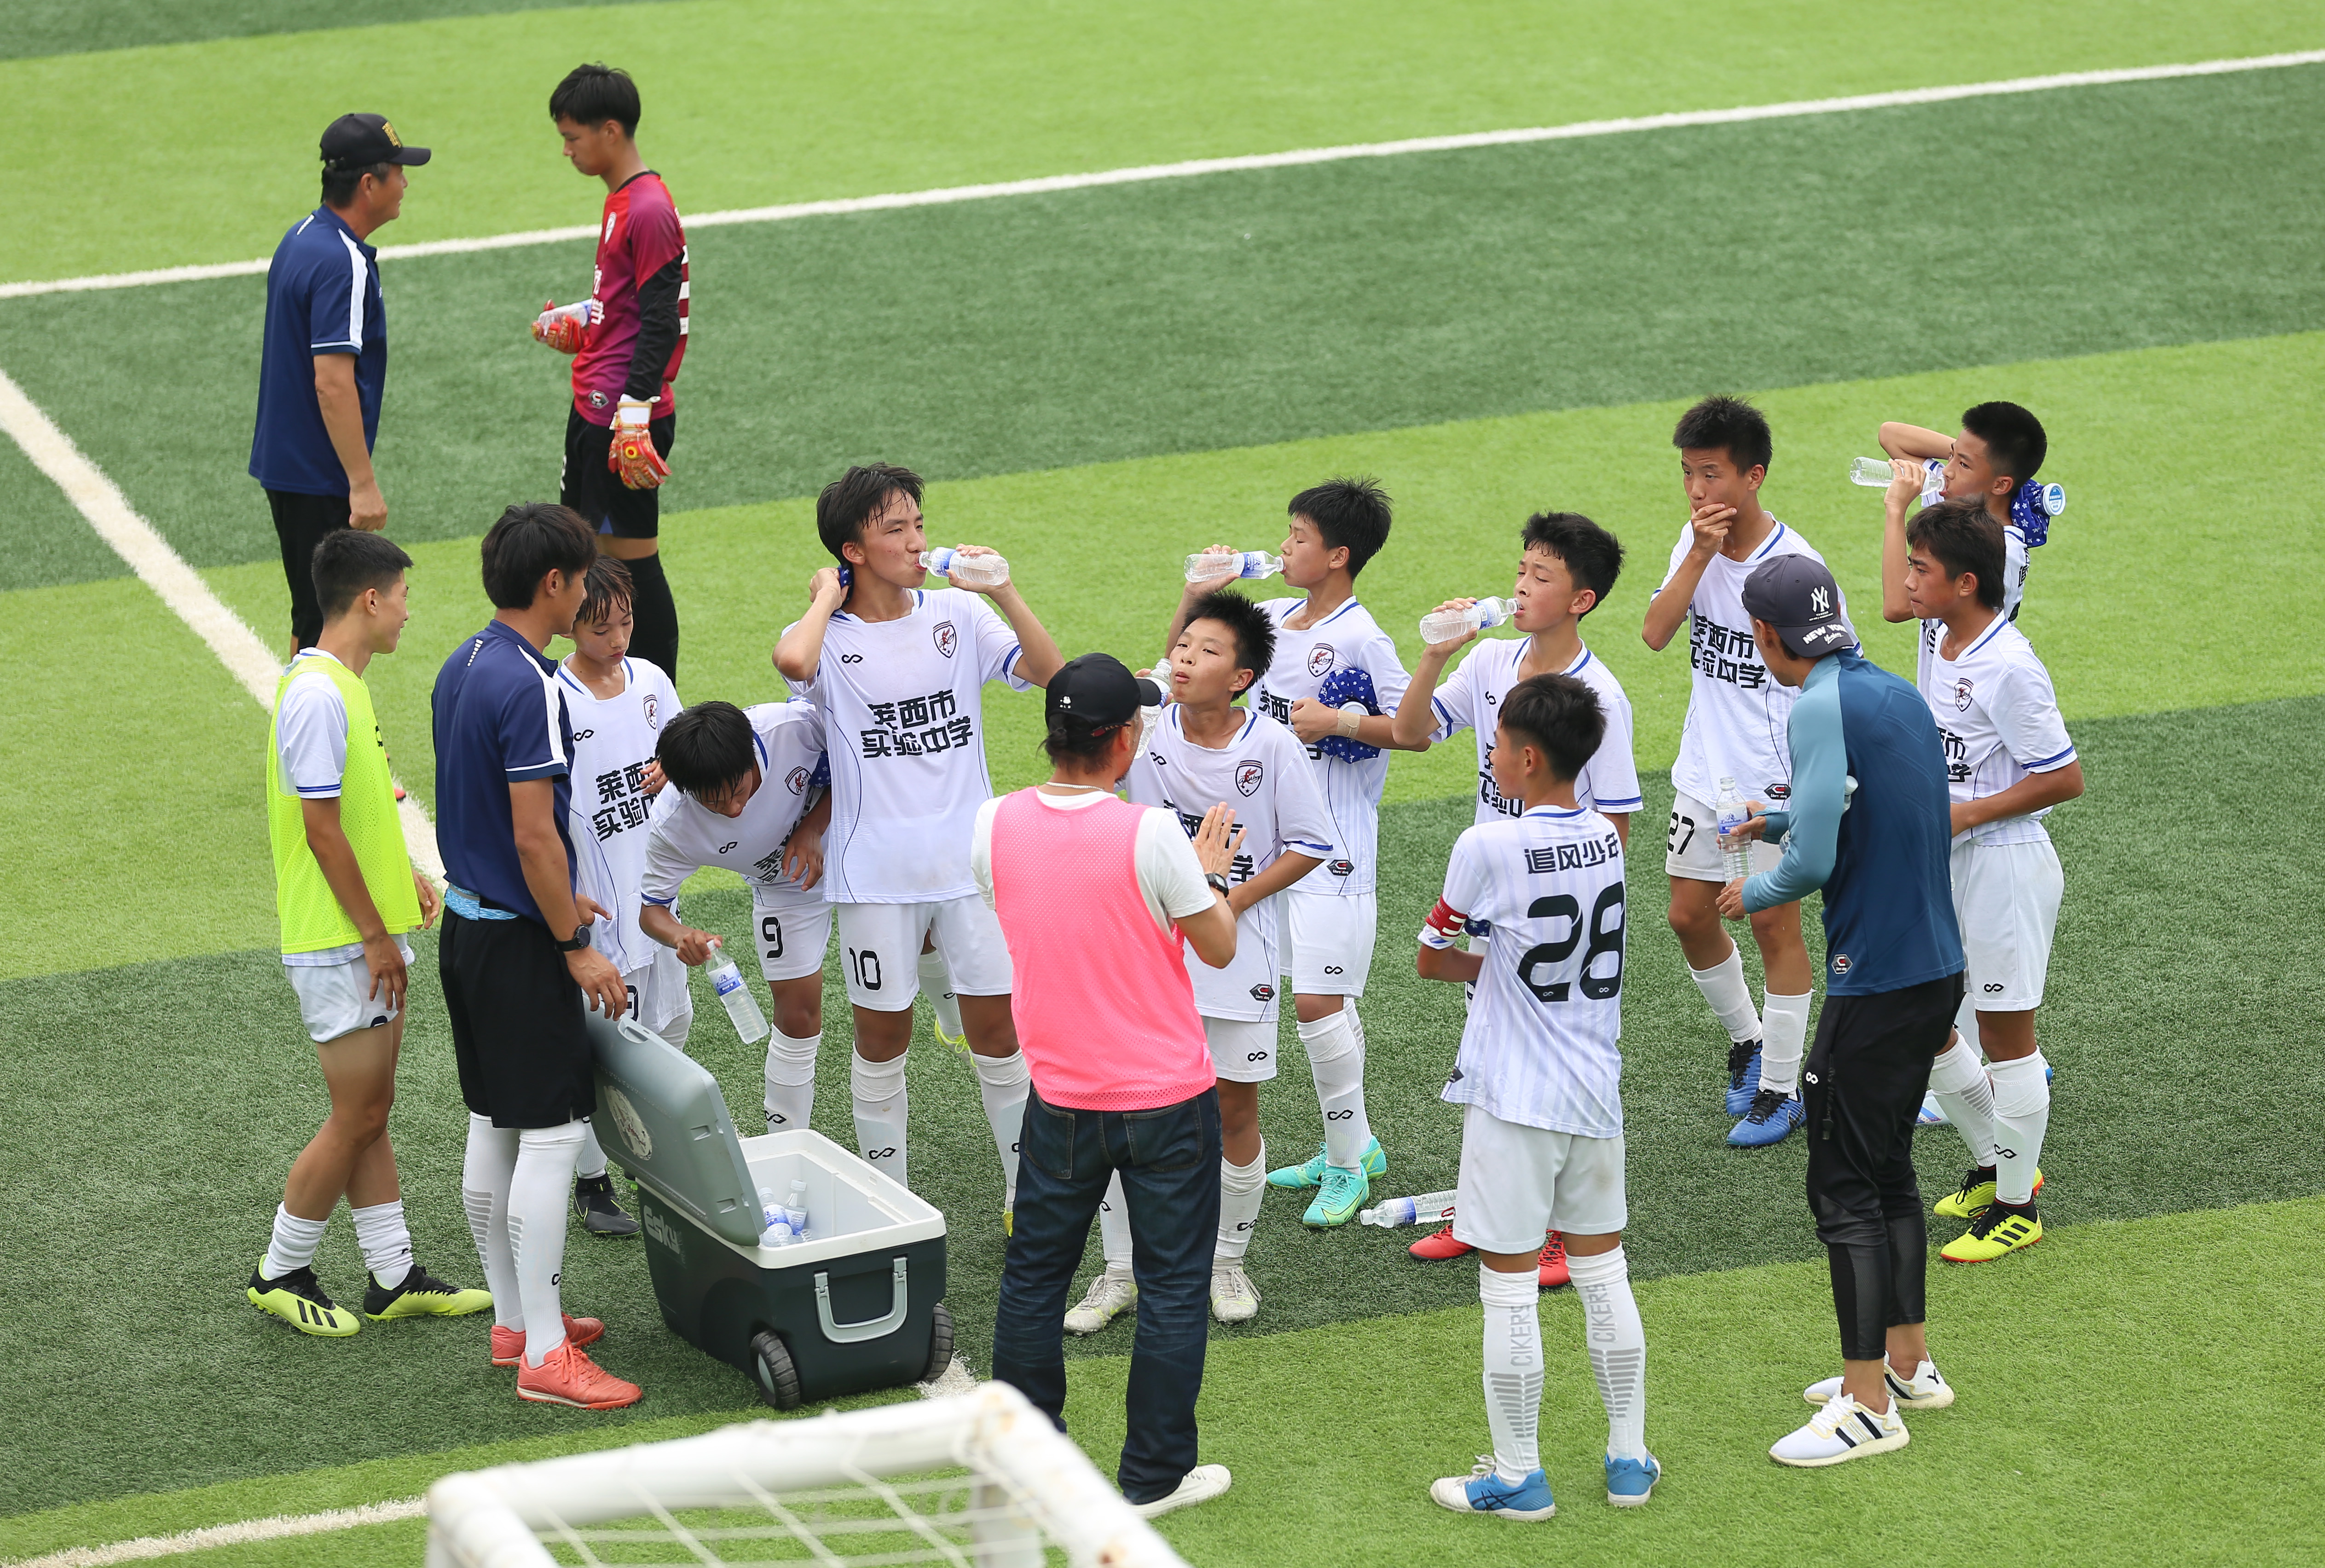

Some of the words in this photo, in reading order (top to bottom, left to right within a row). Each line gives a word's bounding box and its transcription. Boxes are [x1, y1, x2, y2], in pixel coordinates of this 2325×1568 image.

[1803, 626, 1827, 644] NEW
[868, 689, 956, 730] 莱西市
[861, 715, 973, 758] 实验中学
[596, 756, 659, 805] 莱西
[1668, 812, 1695, 855] 27
[762, 917, 783, 958] 9
[1517, 881, 1625, 1002] 28
[849, 947, 882, 991] 10
